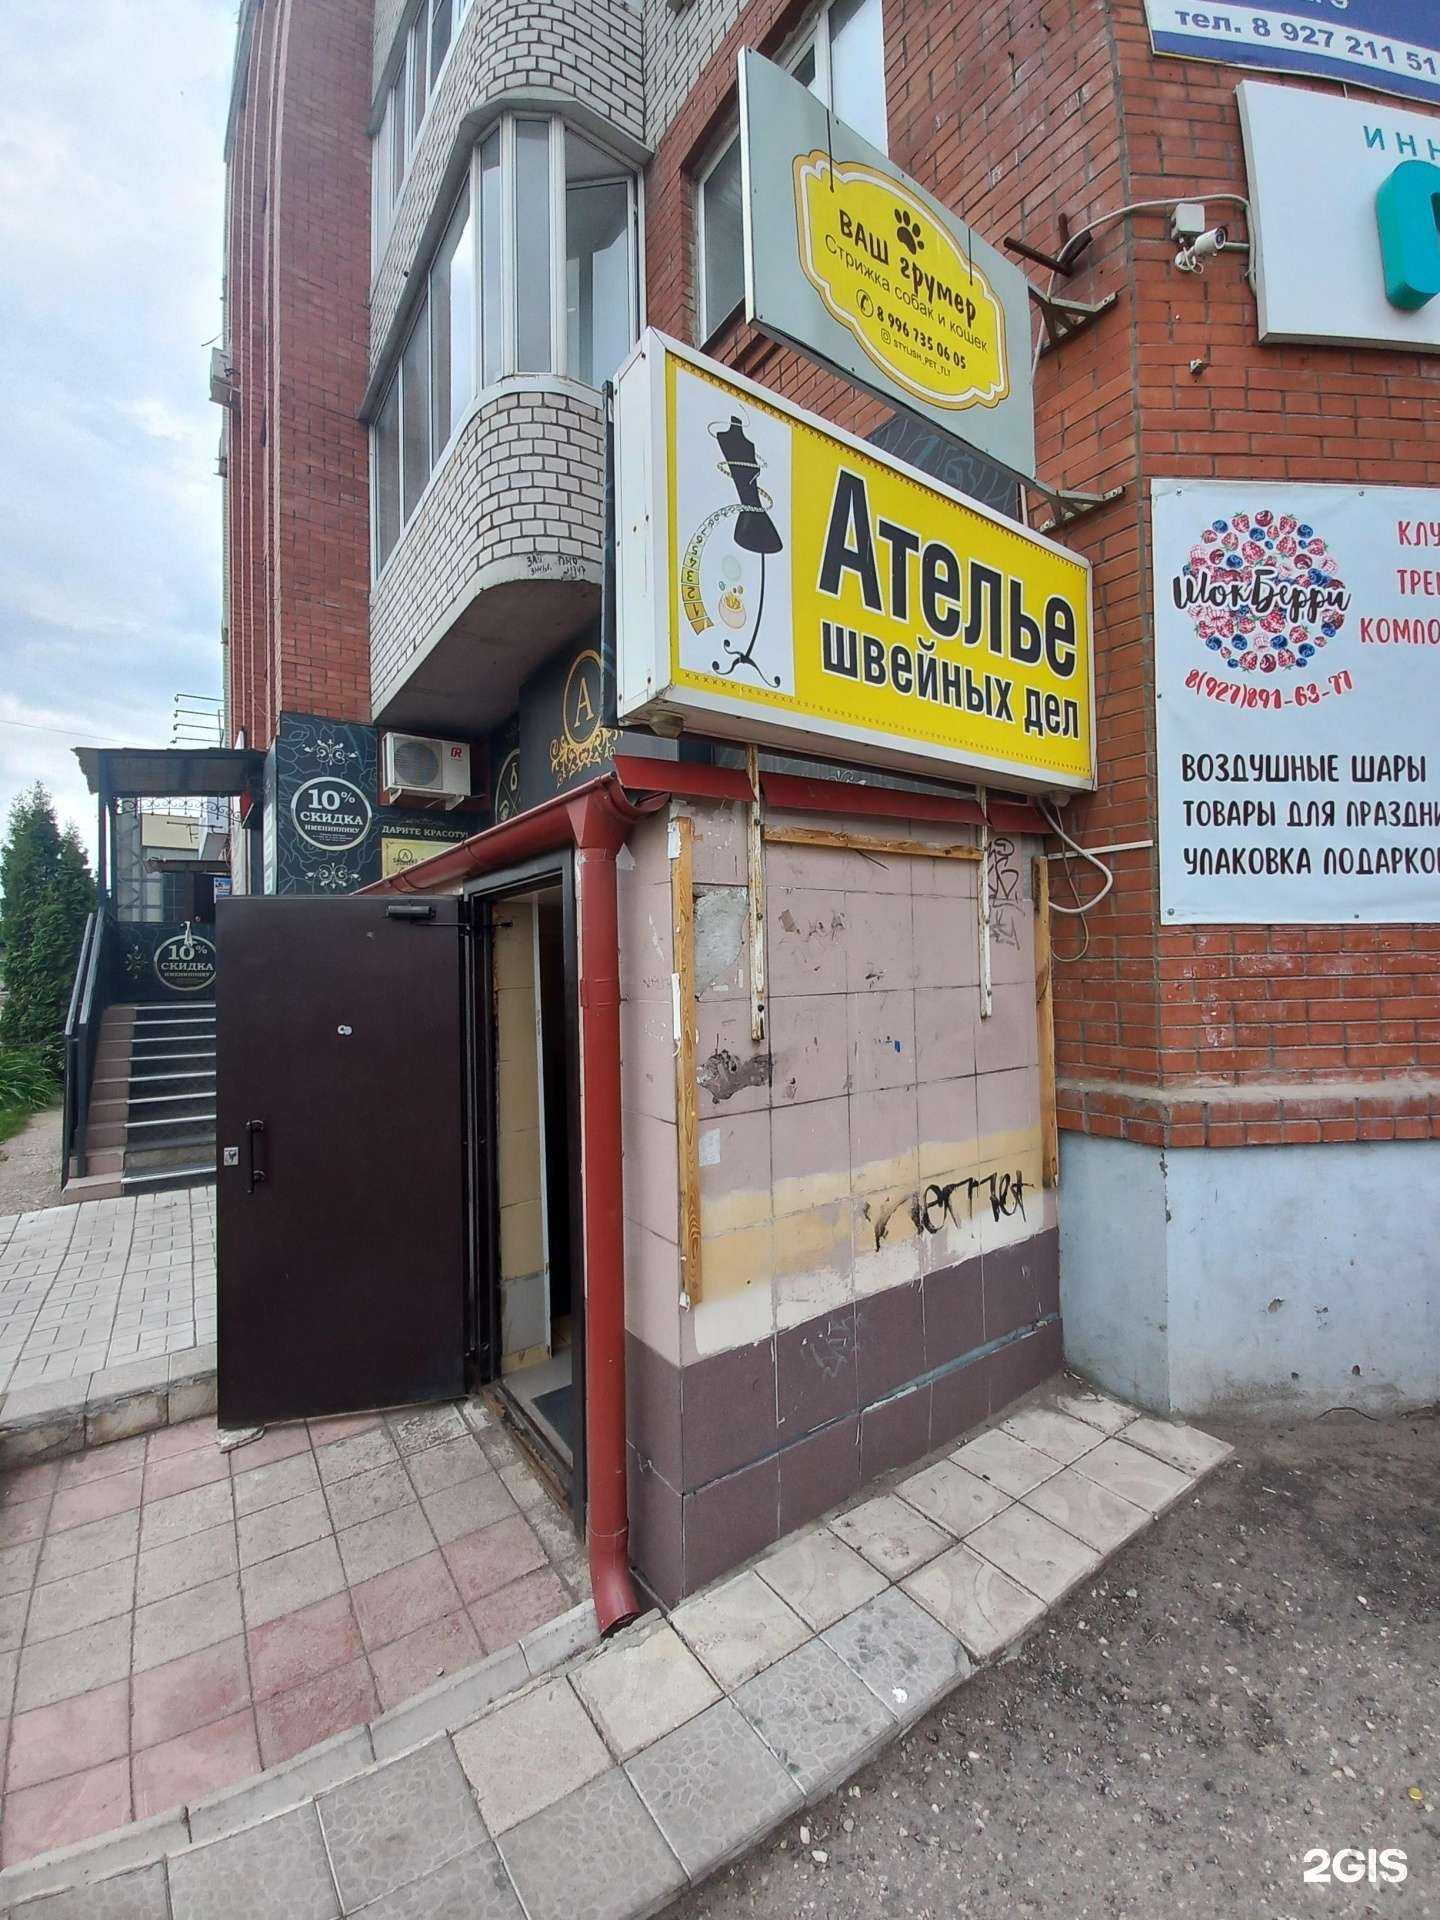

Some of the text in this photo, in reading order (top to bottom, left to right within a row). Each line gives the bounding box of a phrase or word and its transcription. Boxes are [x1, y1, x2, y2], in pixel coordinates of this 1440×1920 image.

[1175, 10, 1437, 76] тел. 8 927 211 51
[839, 207, 977, 329] ВАШ грумер
[825, 233, 989, 353] Стрижка собак и кошек
[877, 306, 967, 370] 8 996 735 06 05
[818, 469, 1077, 678] Ателье
[1397, 569, 1440, 596] ТРЕ
[1172, 568, 1351, 624] ШокБерри
[821, 620, 1080, 739] швейных дел
[1181, 753, 1427, 783] ВОЗДУШНЫЕ ШАРЫ
[308, 788, 356, 810] 10%
[1182, 800, 1277, 827] ТОВАРЫ
[1286, 800, 1335, 827] ДЛЯ
[300, 811, 363, 825] СКИДКА
[382, 825, 421, 836] ДАРИТЕ
[1183, 847, 1440, 876] УПАКОВКА ПОДАРКО
[160, 962, 214, 971] СКИДКА
